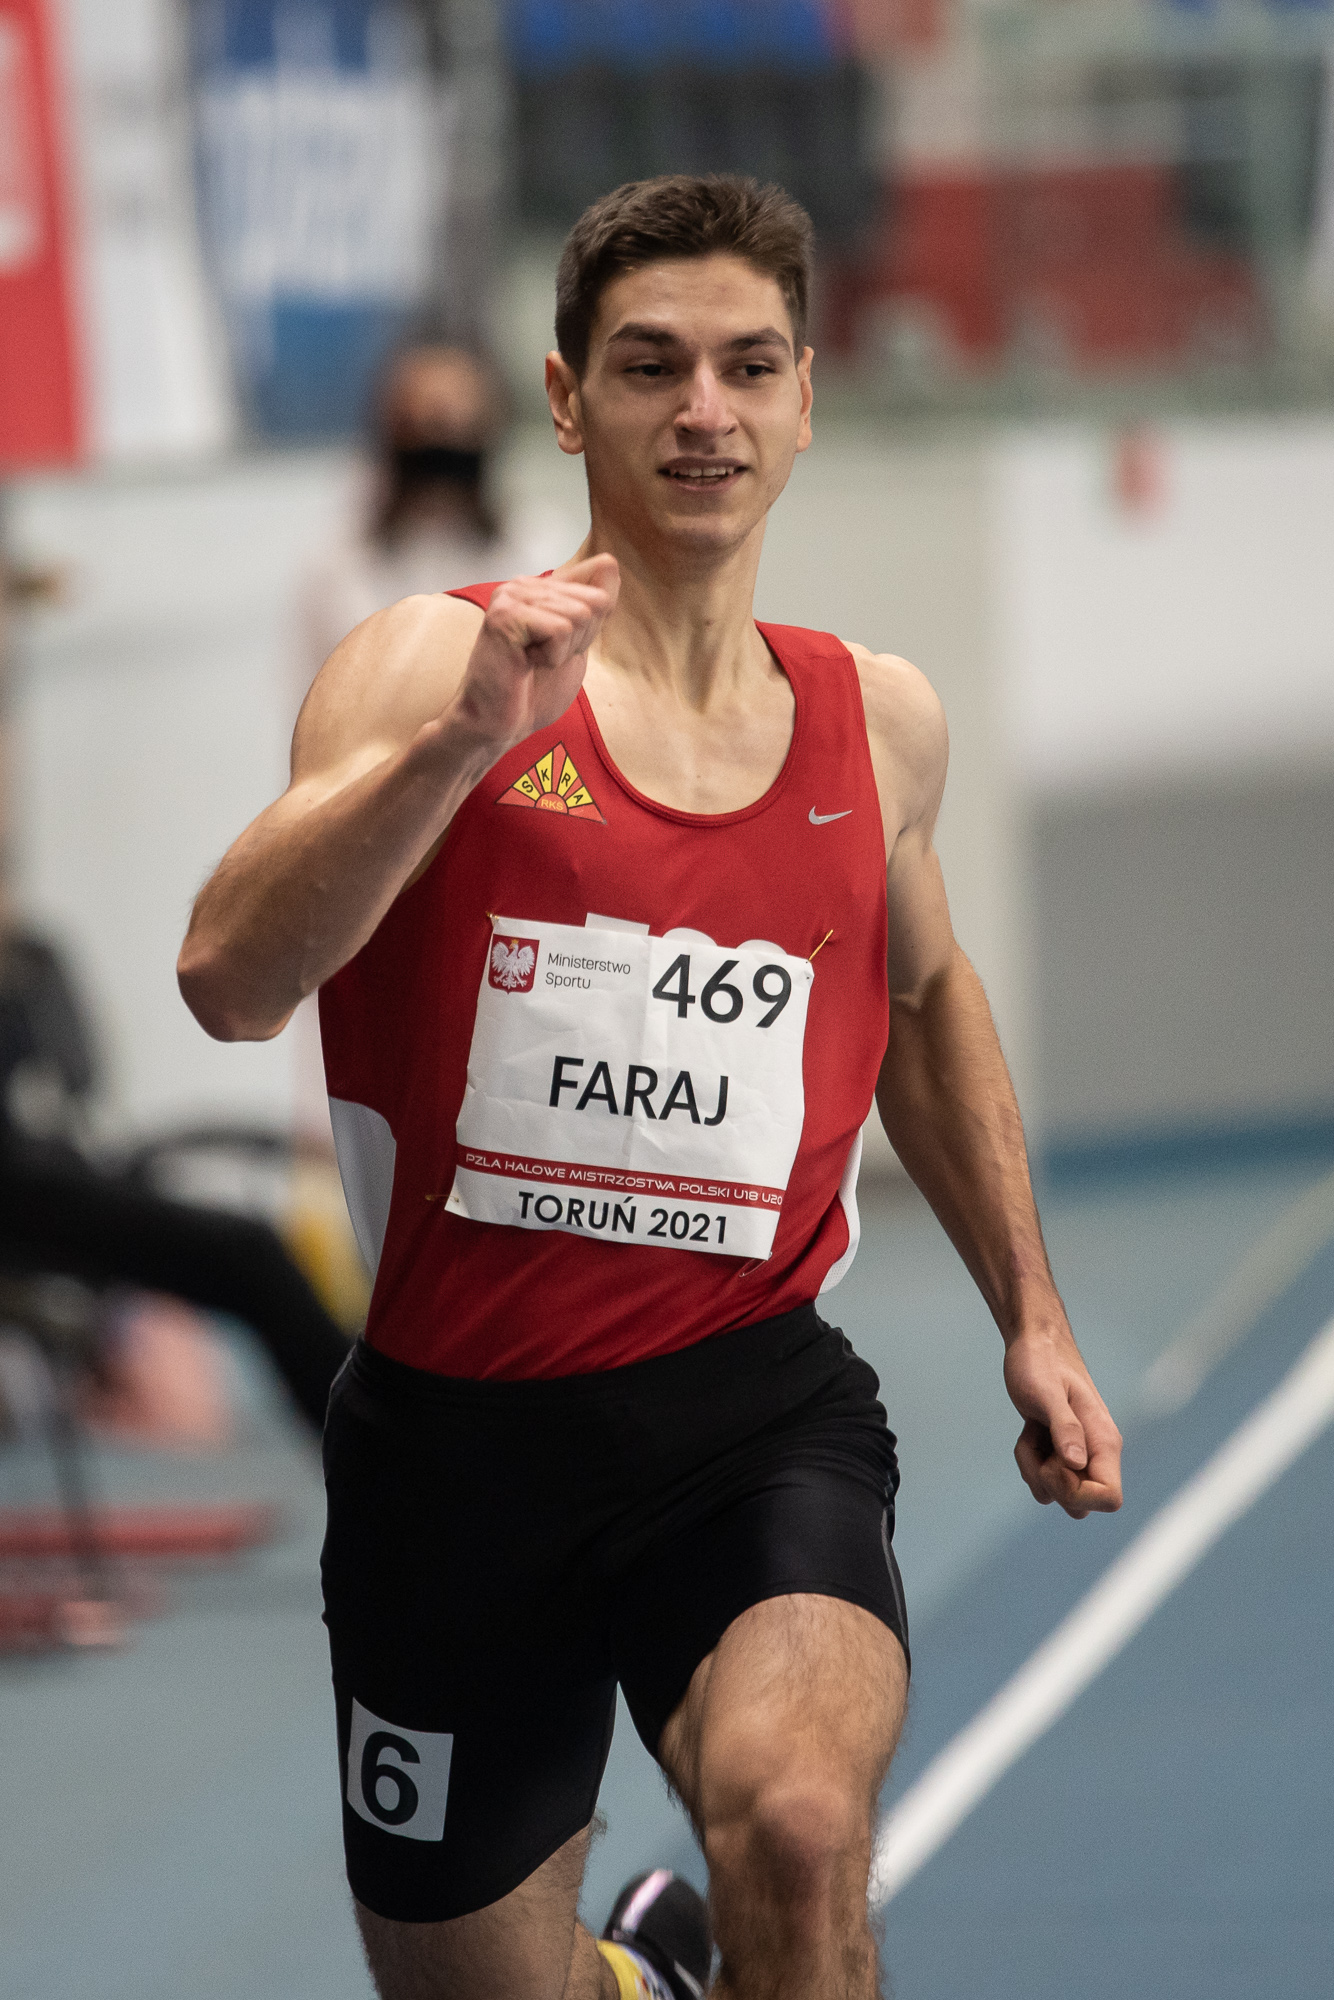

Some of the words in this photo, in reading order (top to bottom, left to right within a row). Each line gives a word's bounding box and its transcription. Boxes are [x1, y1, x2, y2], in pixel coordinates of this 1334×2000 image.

[521, 768, 584, 804] SKRA
[541, 799, 564, 811] RKS
[545, 972, 591, 989] Sportu
[547, 952, 631, 975] Ministerstwo
[652, 954, 792, 1028] 469
[549, 1055, 729, 1126] FARAJ
[466, 1153, 501, 1169] PZLA
[504, 1161, 566, 1178] HALOWE
[569, 1169, 675, 1191] MISTRZOSTWA
[679, 1182, 730, 1198] POLSKI
[733, 1189, 759, 1201] U18
[761, 1192, 783, 1206] U20
[518, 1191, 637, 1234] TORUŃ
[647, 1208, 727, 1244] 2021
[361, 1730, 421, 1826] 6
